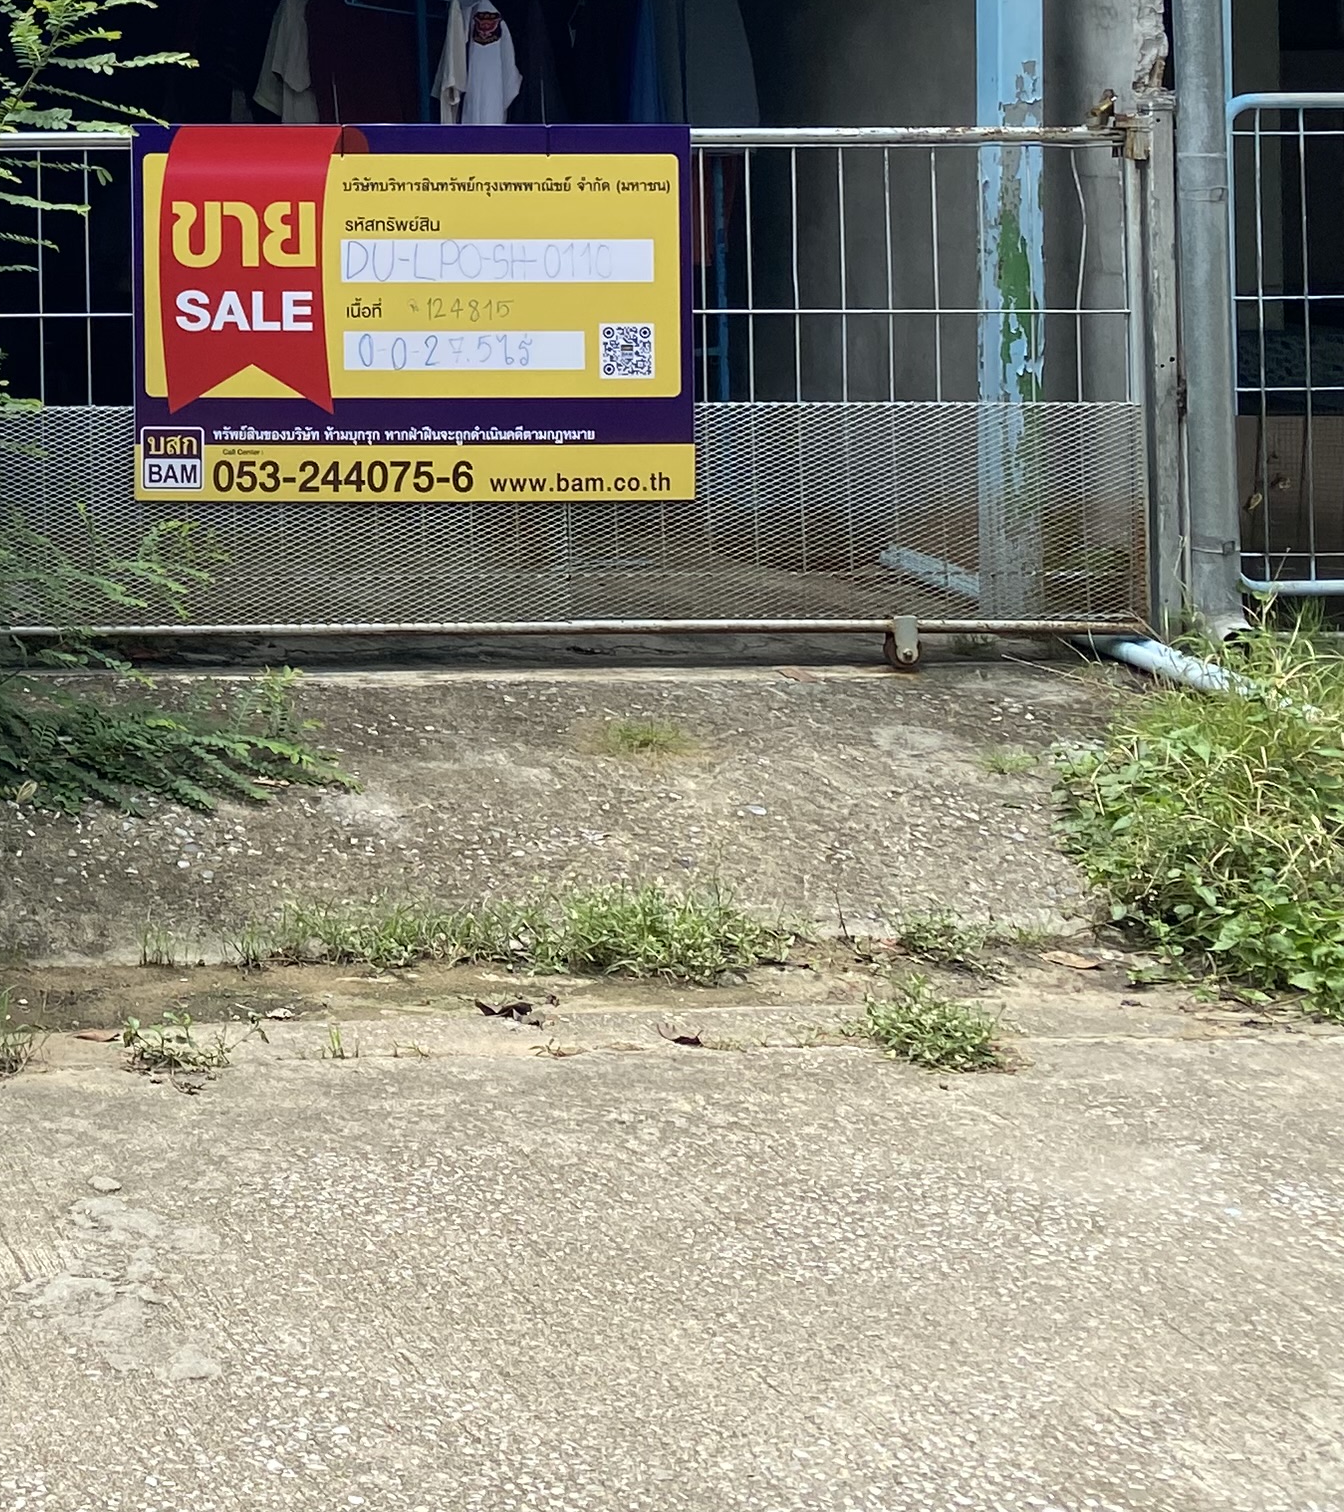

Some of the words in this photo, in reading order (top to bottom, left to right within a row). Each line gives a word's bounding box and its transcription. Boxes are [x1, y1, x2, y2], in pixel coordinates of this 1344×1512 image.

[342, 176, 572, 197] บริษัทบริหารสินทรัพย์กรุงเทพพาณิชย์
[577, 178, 611, 193] จำกัด
[616, 179, 671, 194] (มหาชน)
[171, 201, 316, 268] ขาย
[345, 216, 441, 232] รหัสทรัพย์สิน
[175, 289, 313, 332] SALE
[346, 298, 382, 319] เนื้อที่
[148, 435, 198, 455] บสก
[213, 425, 320, 441] ทรัพย์สินของบริษัท
[324, 427, 380, 445] ห้ามบุกรุก
[148, 463, 197, 484] BAM
[213, 460, 474, 493] 053-244075-6
[489, 472, 671, 492] www.bam.co.th
